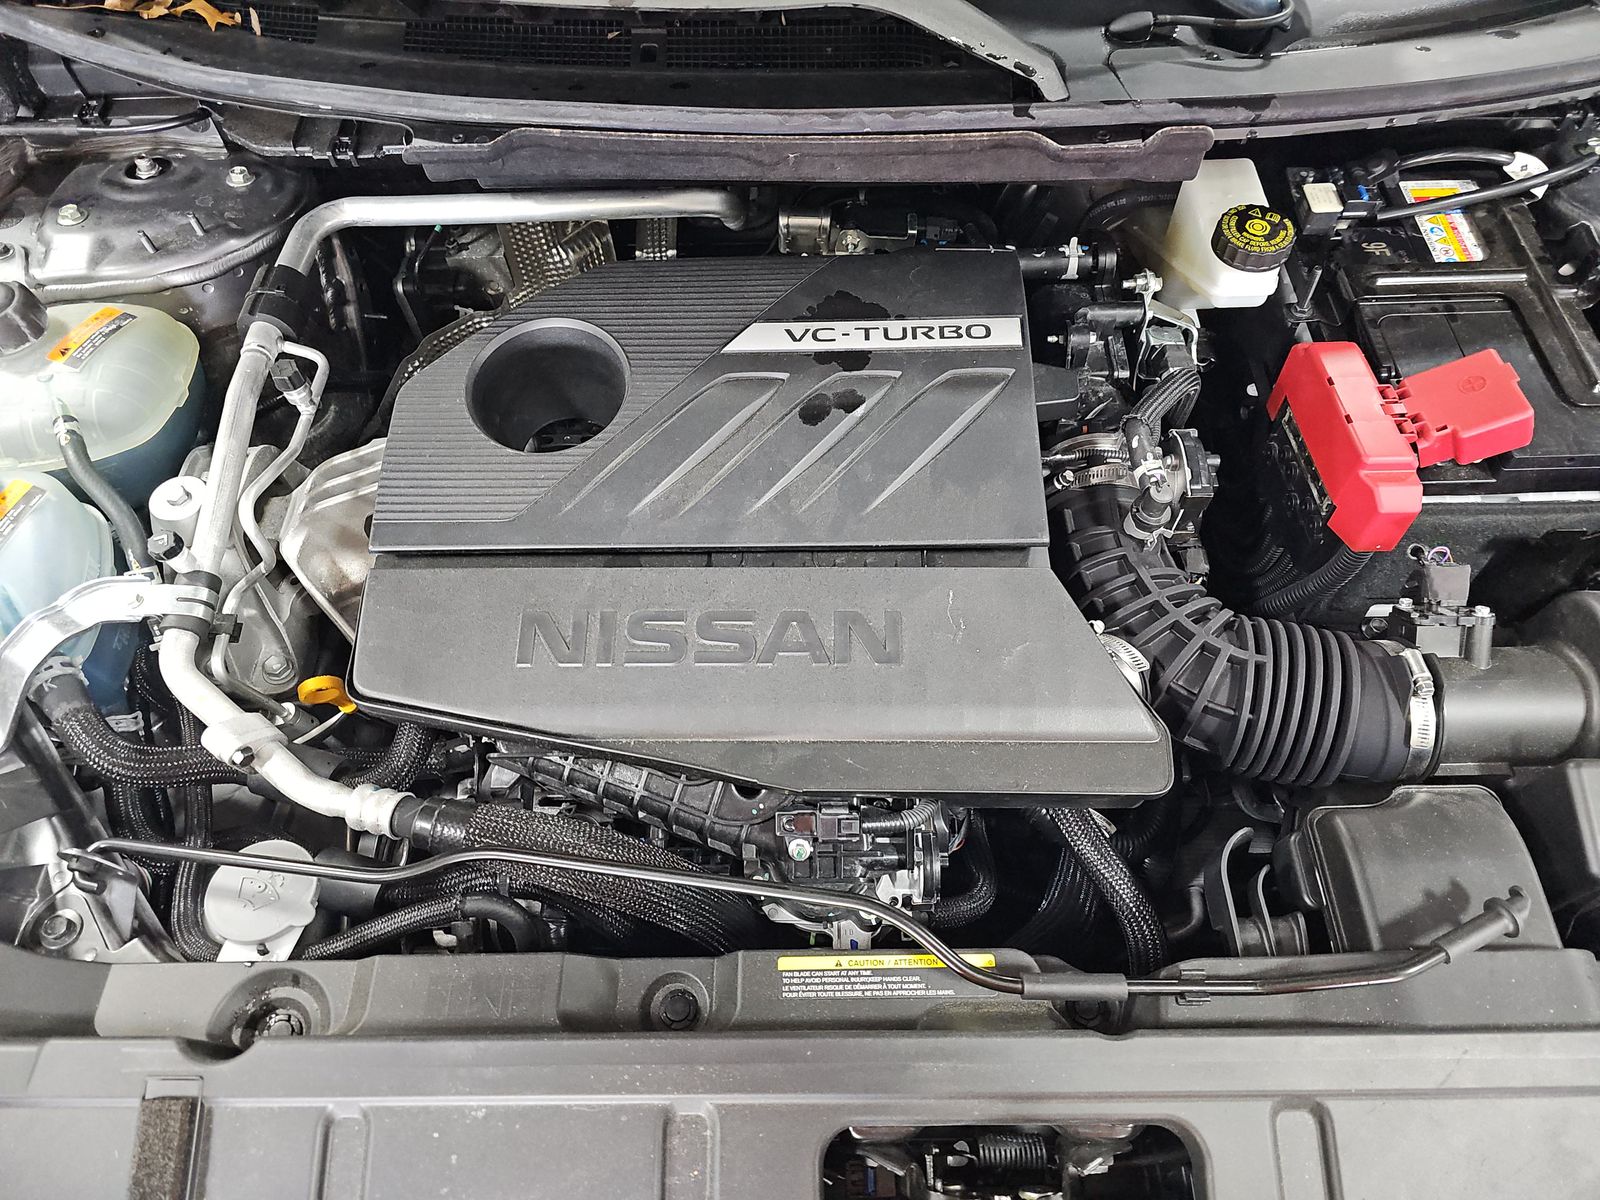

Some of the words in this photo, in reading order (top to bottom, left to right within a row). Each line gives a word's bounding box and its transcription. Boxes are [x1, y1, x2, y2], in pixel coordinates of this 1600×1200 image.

[784, 323, 992, 343] VC-TURBO
[515, 609, 903, 668] NISSAN
[847, 959, 885, 967] CAUTION
[893, 958, 939, 966] ATTENTION
